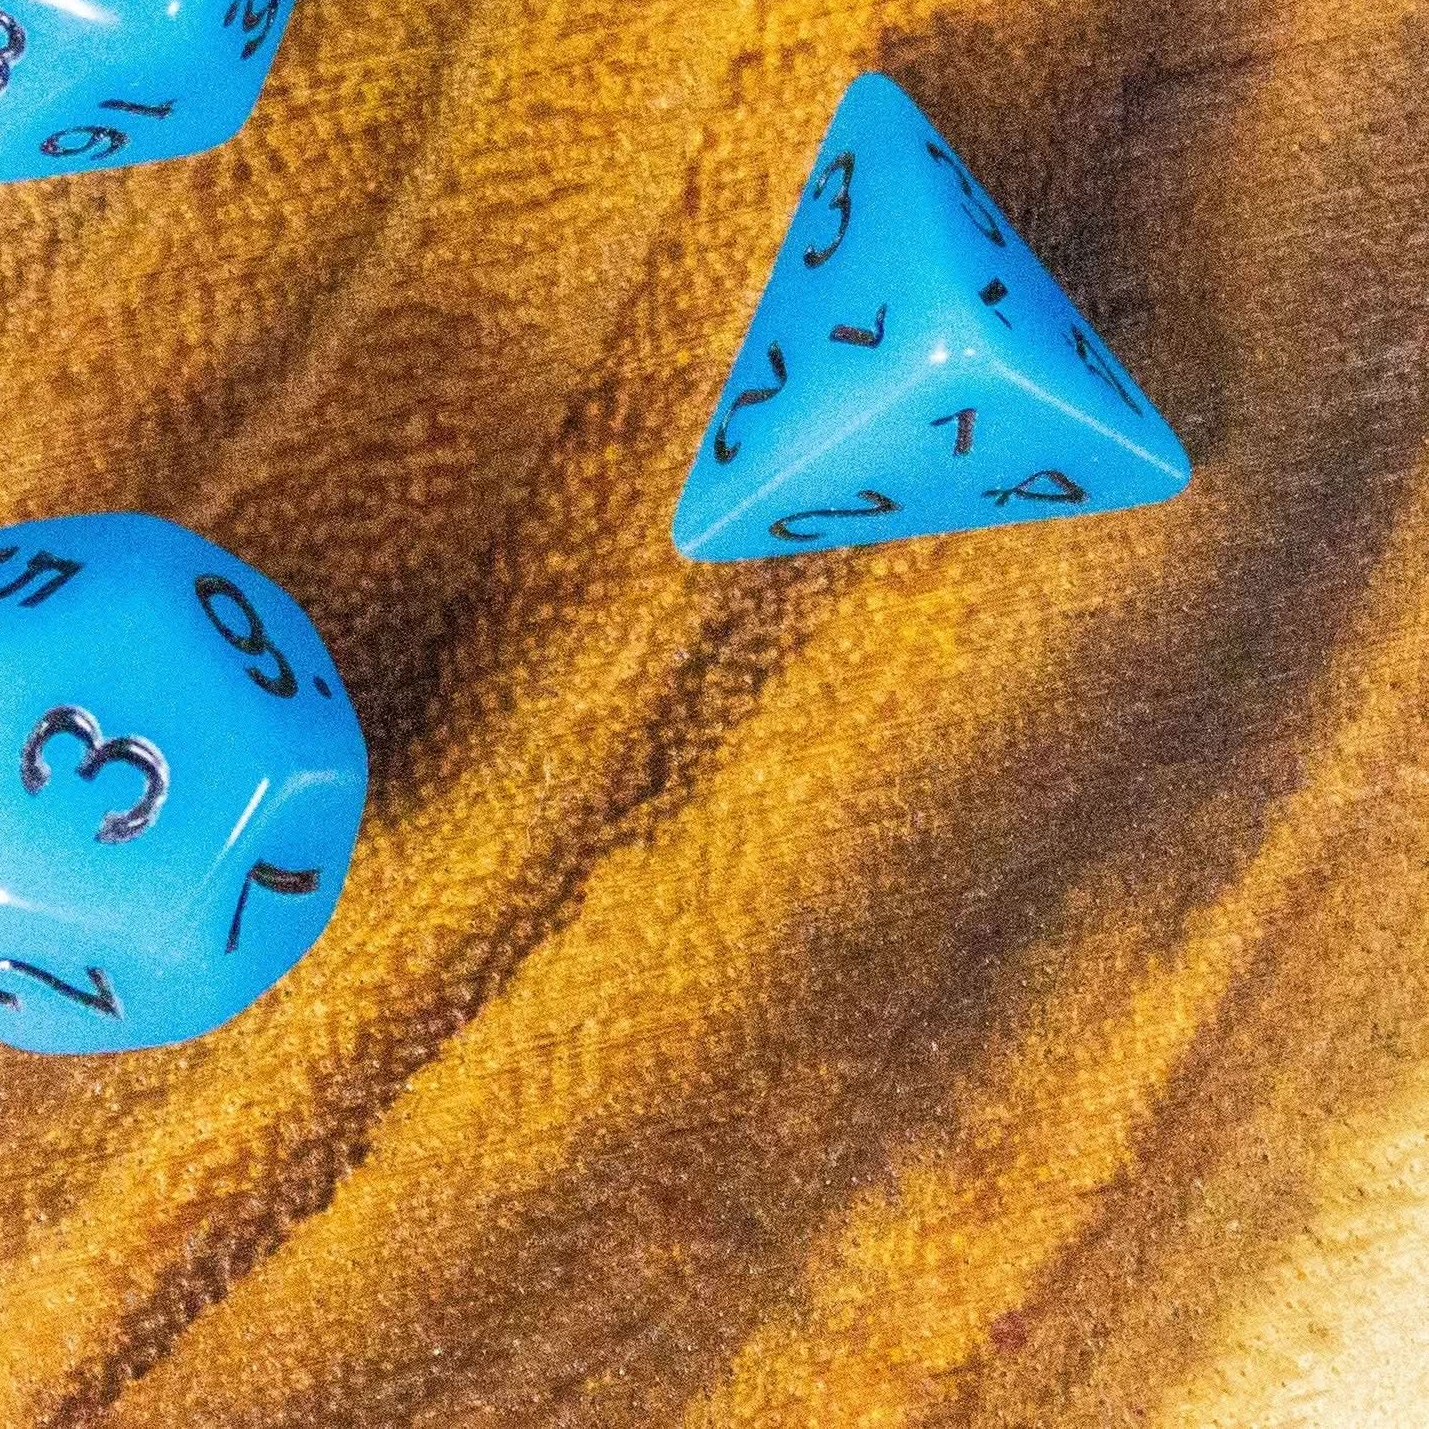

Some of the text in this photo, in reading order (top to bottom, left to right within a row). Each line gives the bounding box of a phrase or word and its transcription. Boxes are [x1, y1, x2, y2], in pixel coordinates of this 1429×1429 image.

[803, 149, 856, 269] 3
[713, 337, 788, 465] 2
[929, 406, 978, 458] 1
[769, 488, 904, 541] 2
[981, 468, 1089, 508] 4
[20, 703, 171, 844] 3
